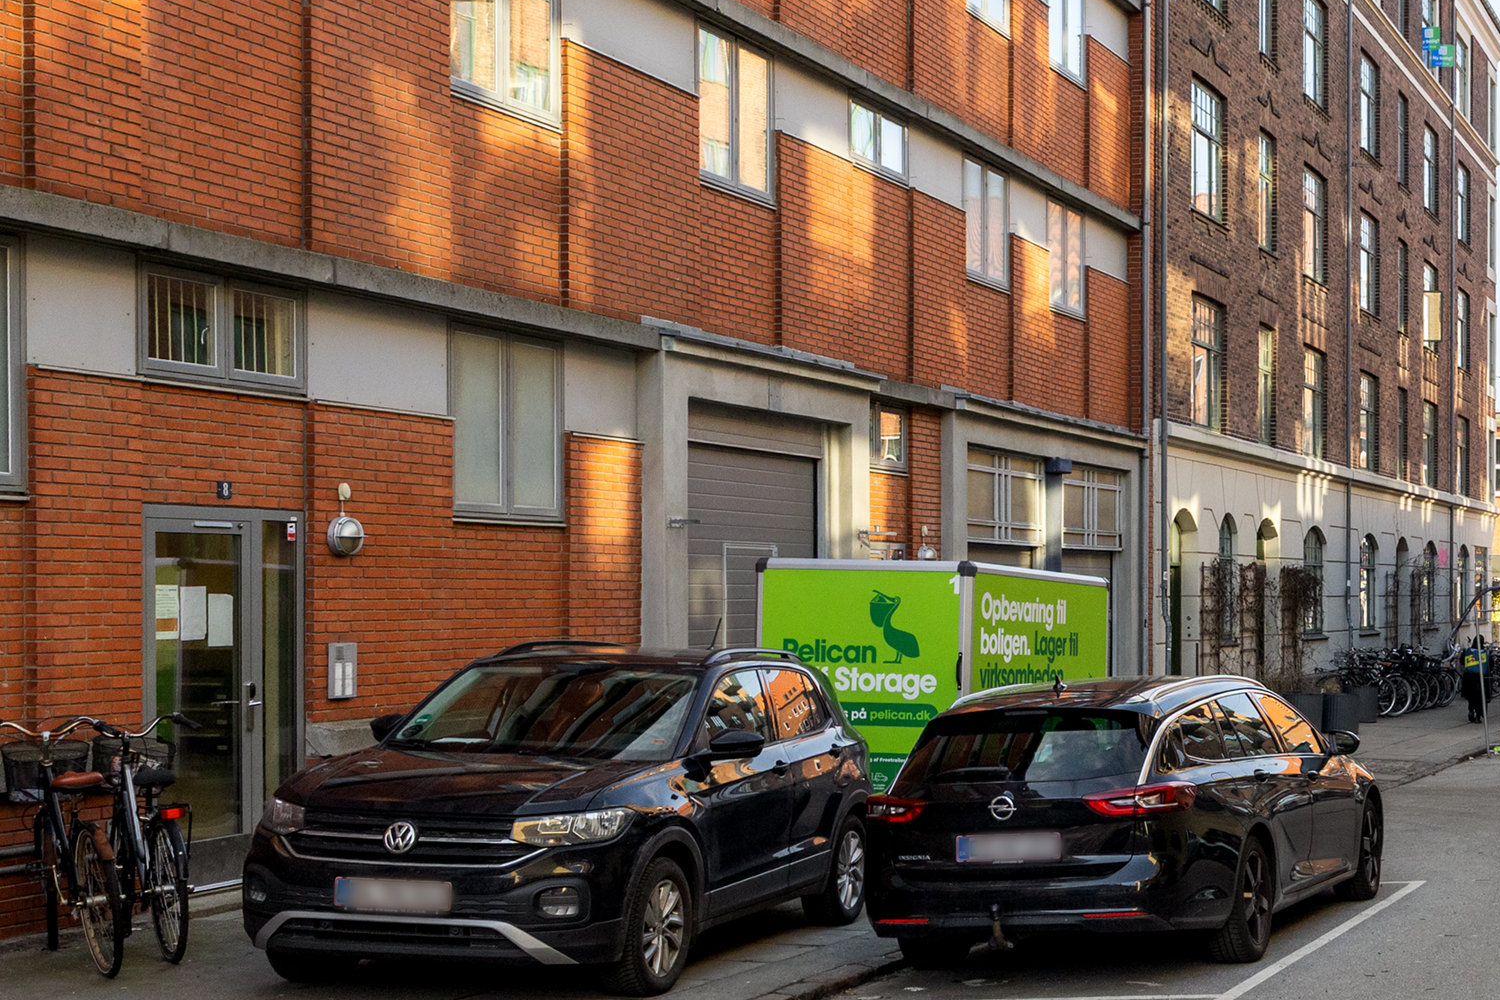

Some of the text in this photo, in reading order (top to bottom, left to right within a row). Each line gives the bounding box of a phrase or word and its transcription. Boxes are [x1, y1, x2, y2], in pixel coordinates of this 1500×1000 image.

[222, 482, 229, 496] 8
[981, 592, 1067, 631] Opbevaring til
[783, 638, 877, 664] Pelican
[980, 627, 1079, 663] boligen. Lager til
[834, 666, 938, 700] Storage
[851, 707, 867, 721] på
[870, 708, 931, 722] pelican.dk
